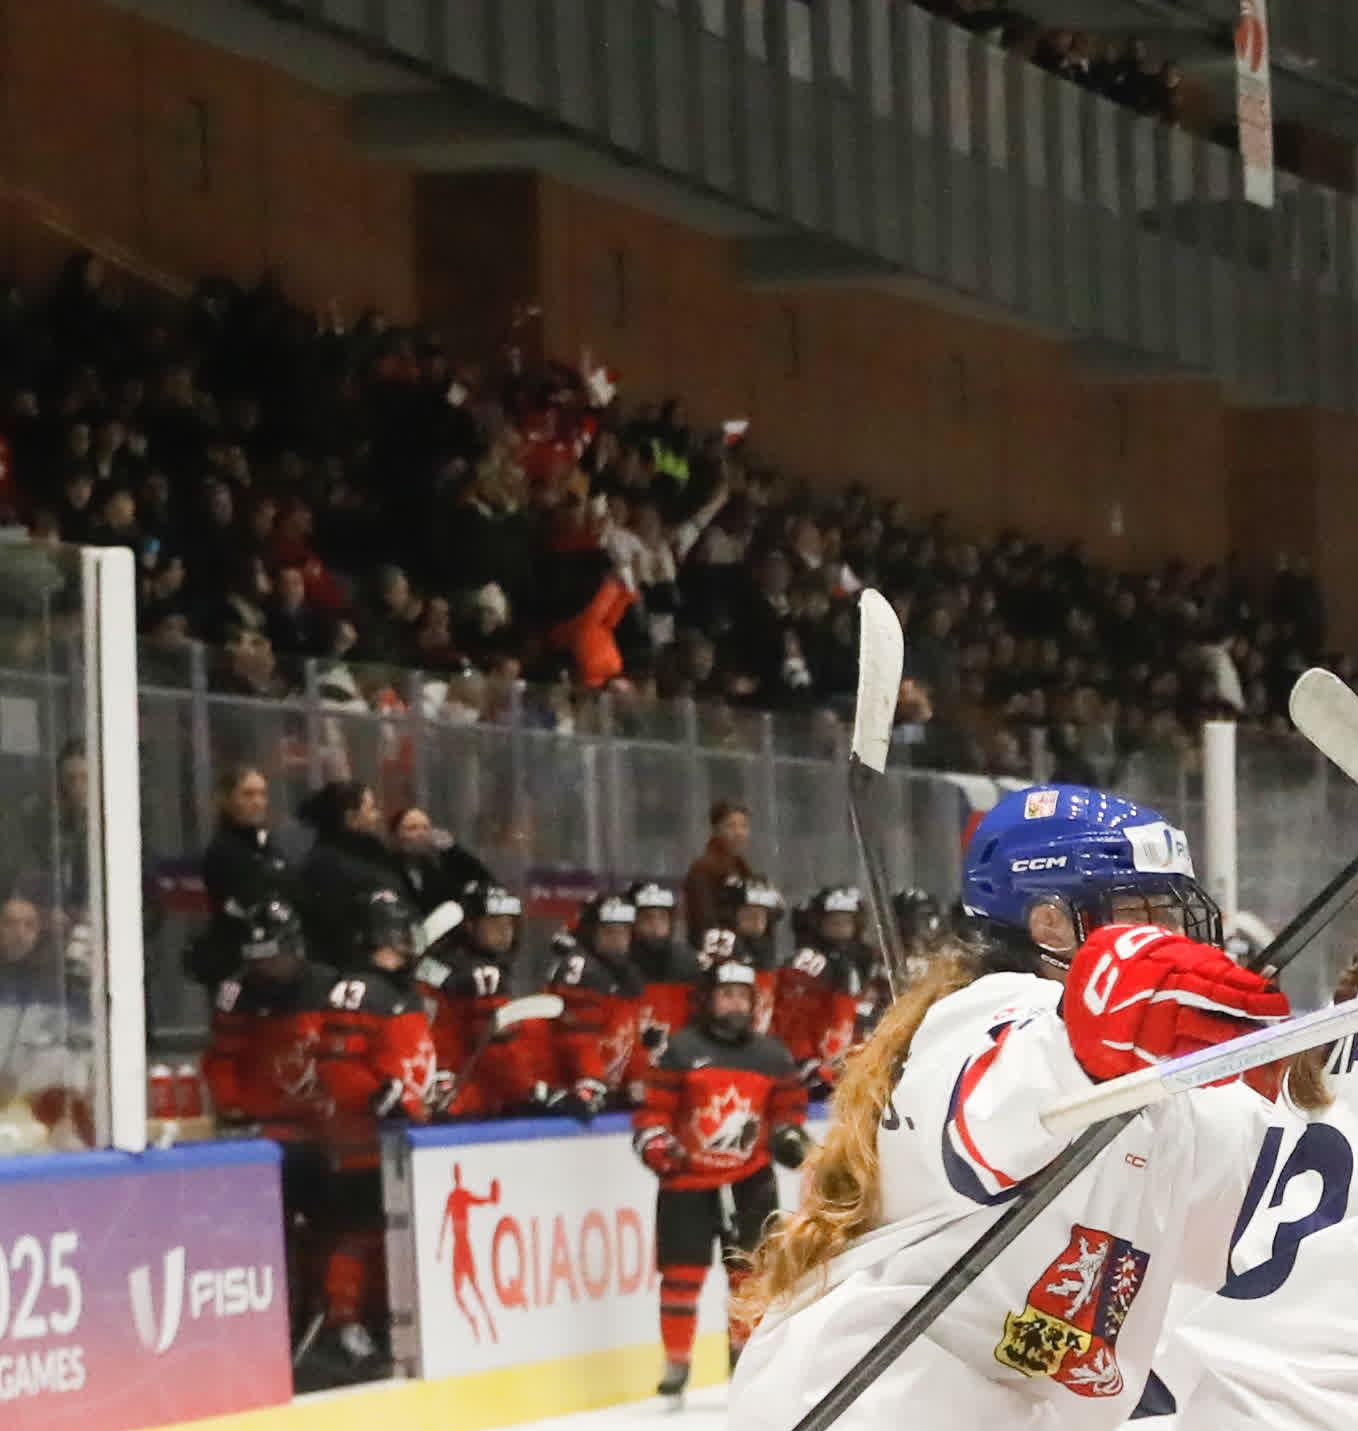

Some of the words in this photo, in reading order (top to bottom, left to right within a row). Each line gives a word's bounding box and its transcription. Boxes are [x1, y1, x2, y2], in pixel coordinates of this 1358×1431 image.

[1011, 855, 1068, 873] CCM
[0, 1231, 83, 1341] 25
[491, 1209, 658, 1312] QIAOD
[189, 1263, 274, 1320] FISU
[0, 1346, 86, 1400] GAMES
